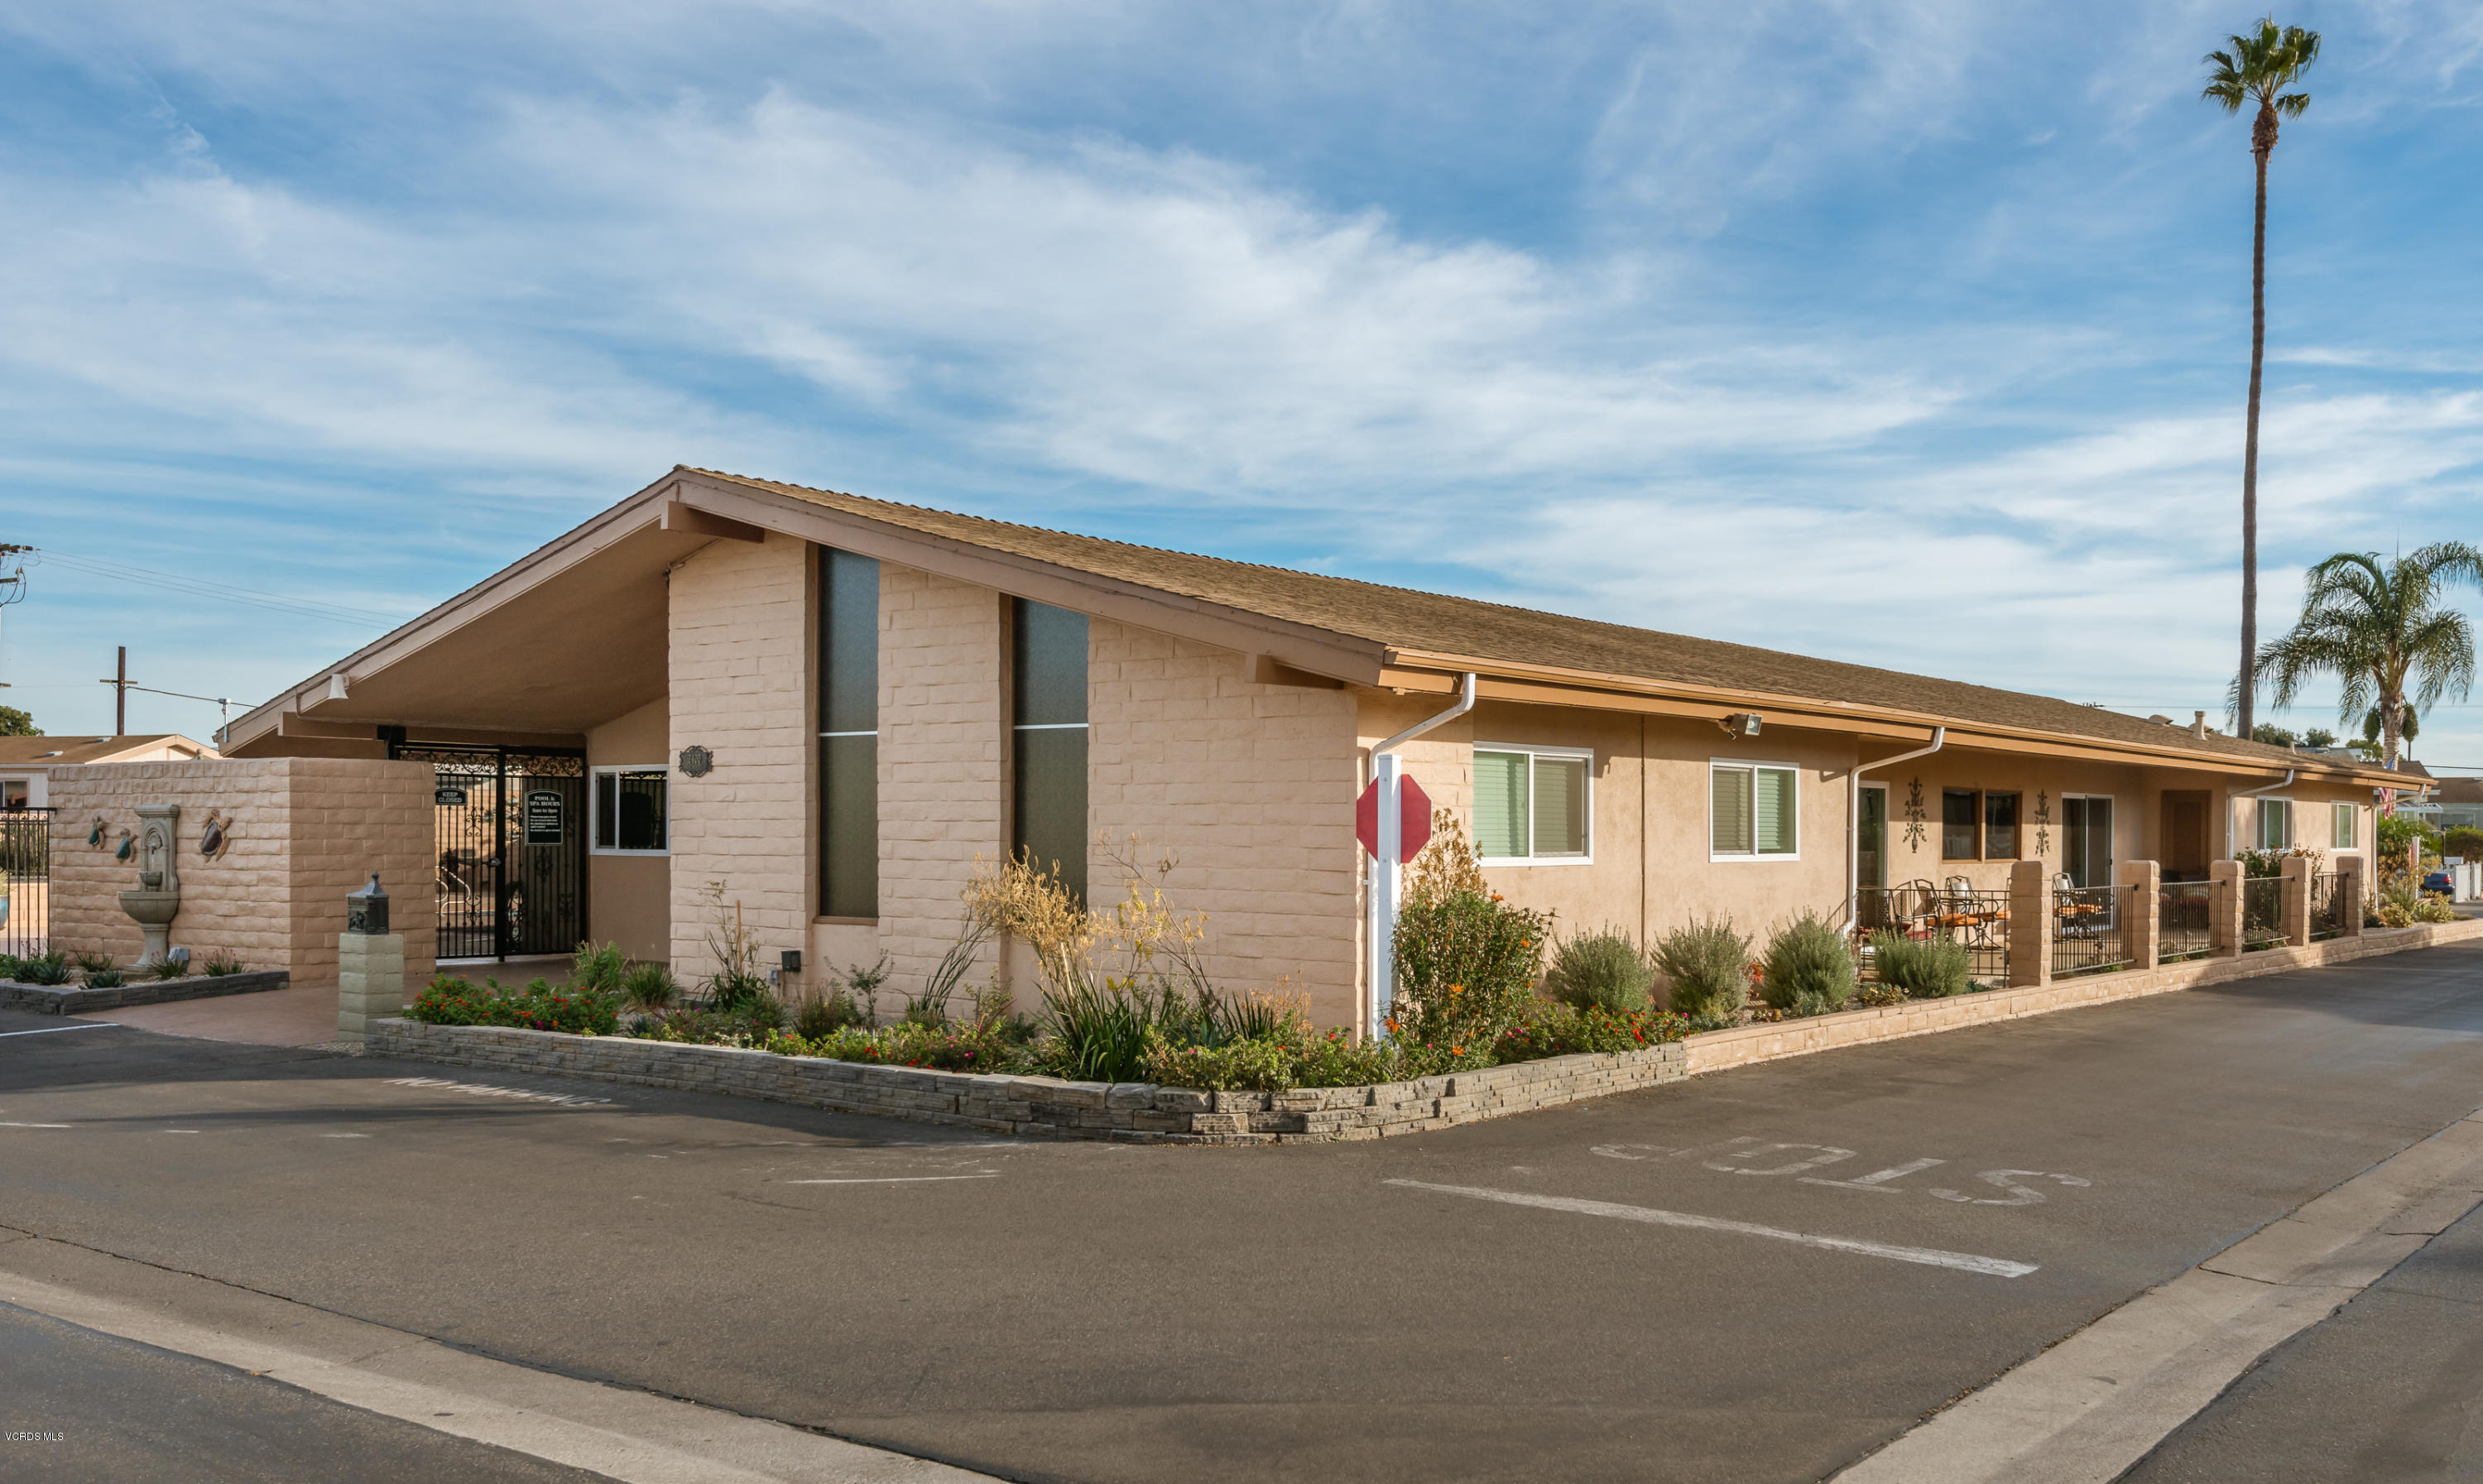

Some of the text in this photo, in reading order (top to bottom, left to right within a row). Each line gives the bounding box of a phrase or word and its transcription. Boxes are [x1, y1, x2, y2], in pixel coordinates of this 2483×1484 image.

[382, 1077, 612, 1107] NO PARKING
[1588, 1136, 2092, 1206] STOP
